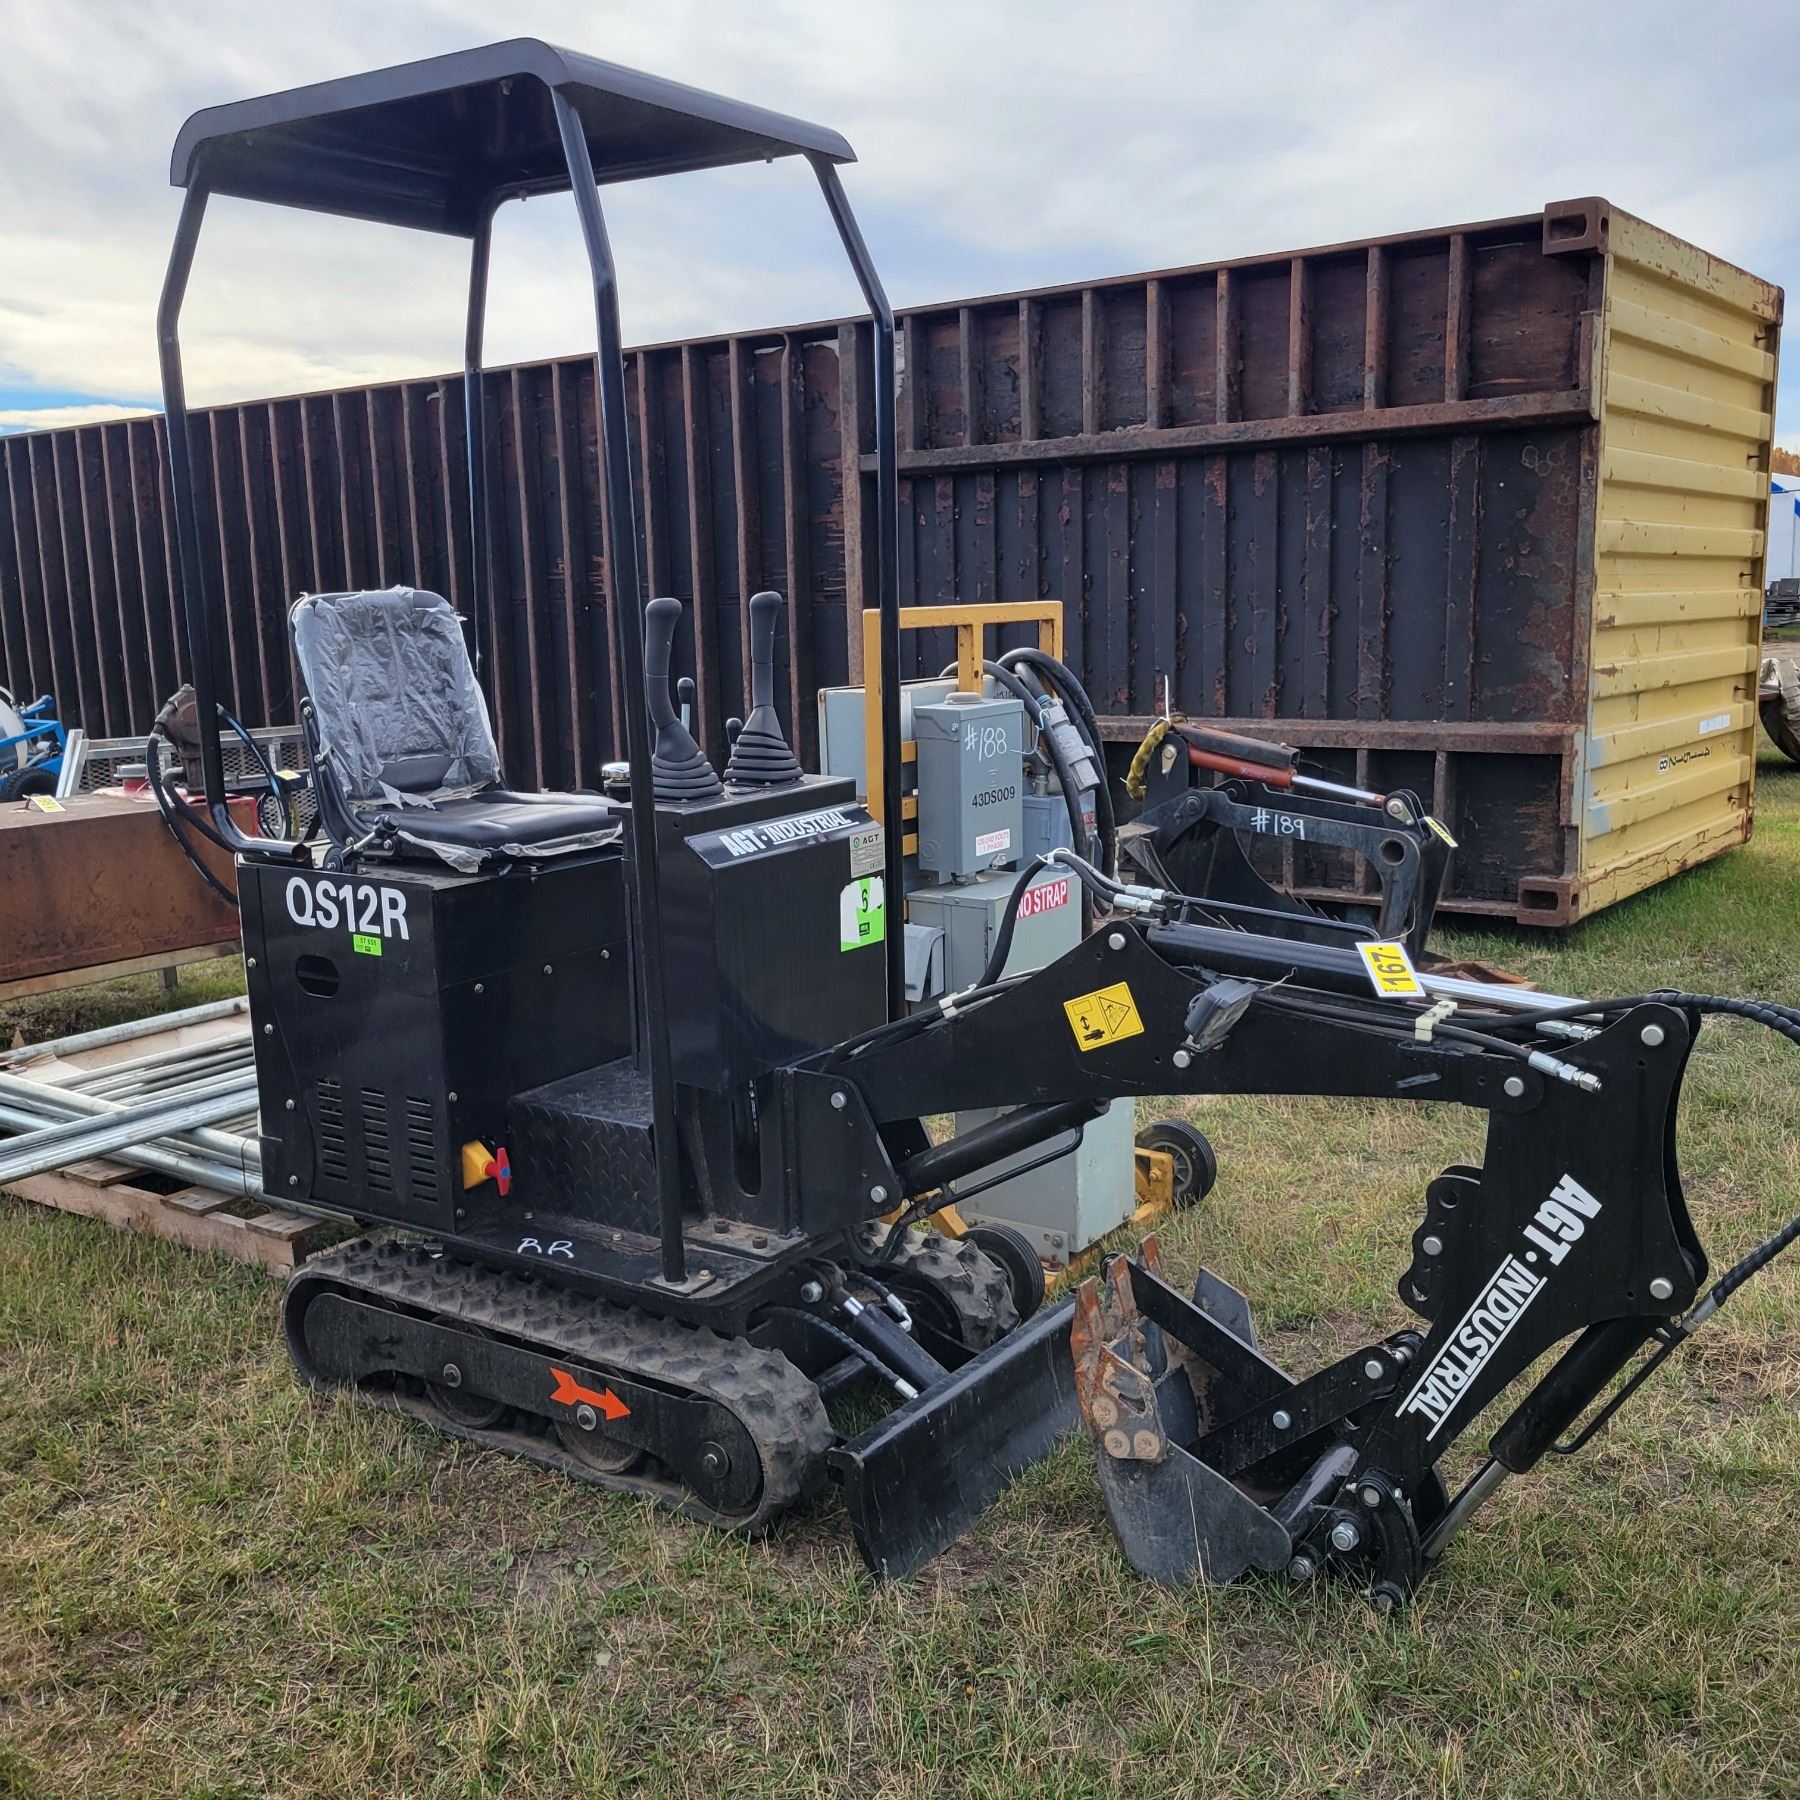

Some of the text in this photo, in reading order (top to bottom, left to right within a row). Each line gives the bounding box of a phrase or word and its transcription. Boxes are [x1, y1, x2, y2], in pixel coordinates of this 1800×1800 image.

[965, 723, 1008, 762] #188
[972, 785, 1016, 808] 43DS009
[718, 810, 852, 857] AGT INDUSTRIAL
[862, 833, 880, 845] AGT
[1250, 807, 1306, 841] #189
[286, 876, 409, 940] QS12R
[1016, 881, 1067, 919] NO STRAP
[1522, 1173, 1602, 1266] AGT
[1407, 1258, 1540, 1423] INDUSTRIAL
